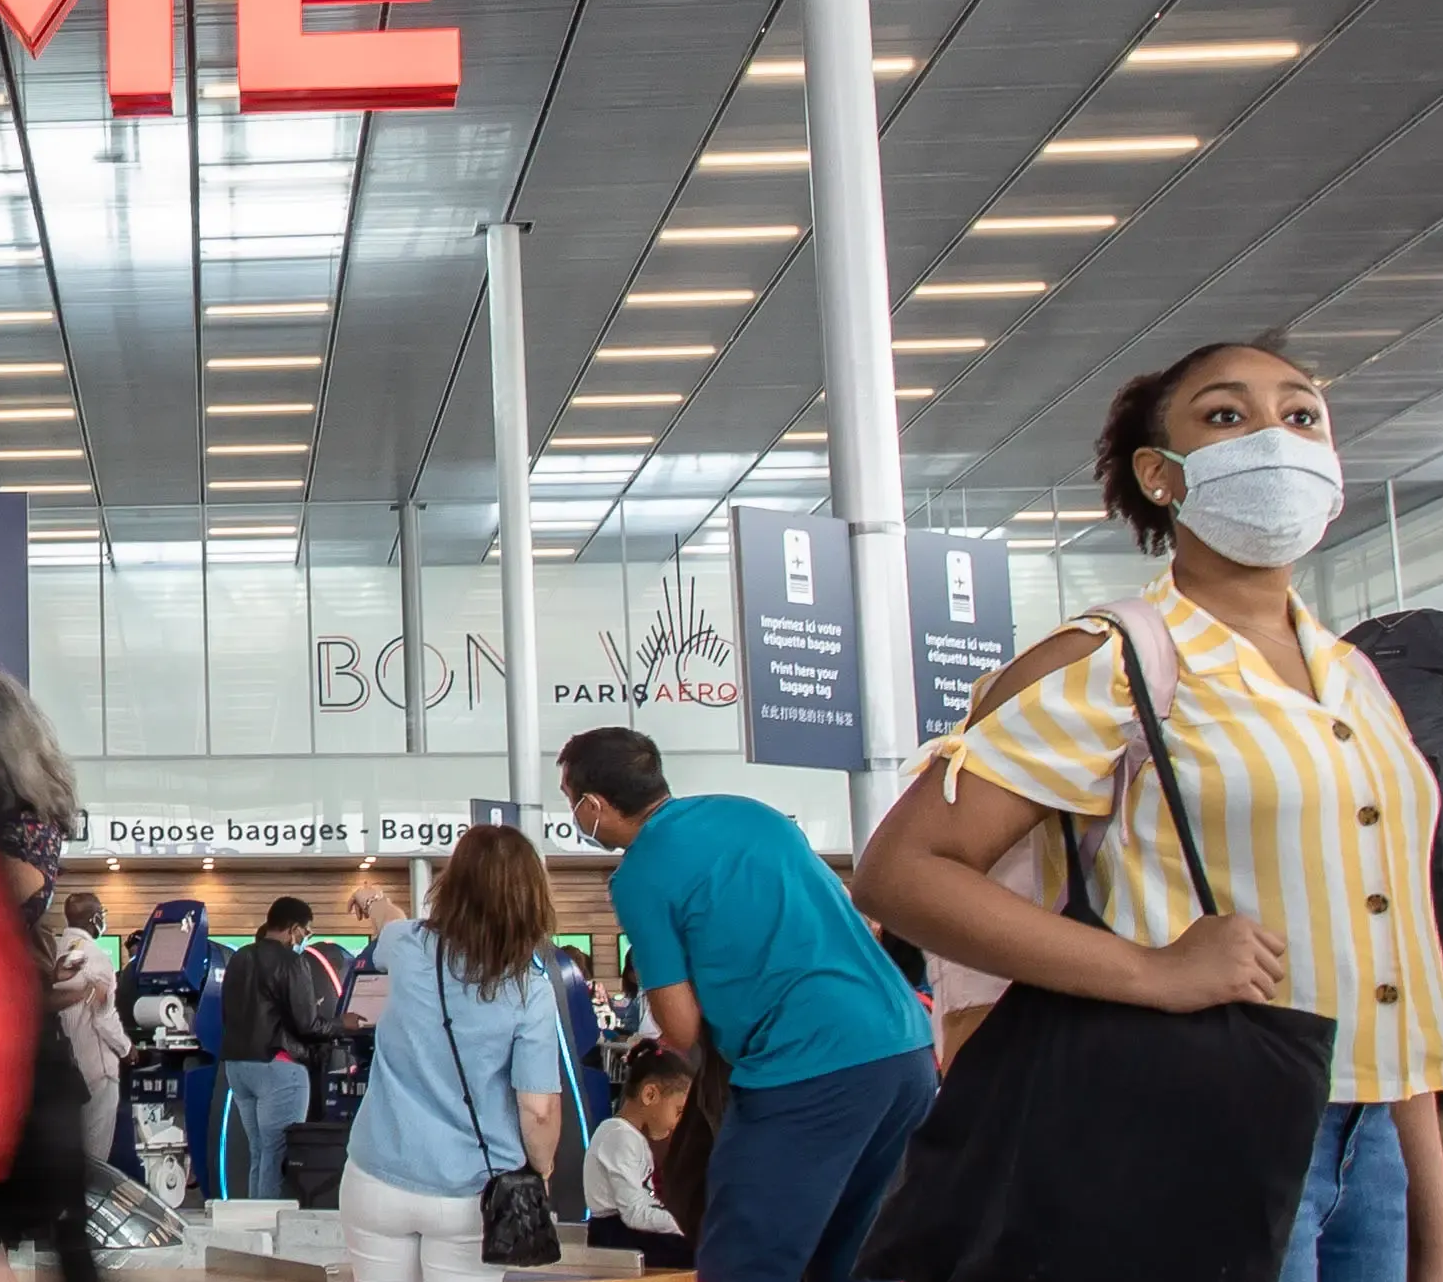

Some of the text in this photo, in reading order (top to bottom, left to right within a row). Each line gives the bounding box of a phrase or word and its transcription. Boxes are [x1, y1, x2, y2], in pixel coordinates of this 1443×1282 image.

[760, 615, 804, 633] Imprimez
[817, 622, 843, 637] votre
[807, 635, 842, 655] bagage
[770, 660, 839, 681] Print here your
[555, 683, 649, 704] PARIS
[779, 678, 832, 699] bagage tag
[110, 818, 215, 847] Dépose
[227, 818, 349, 847] bagages
